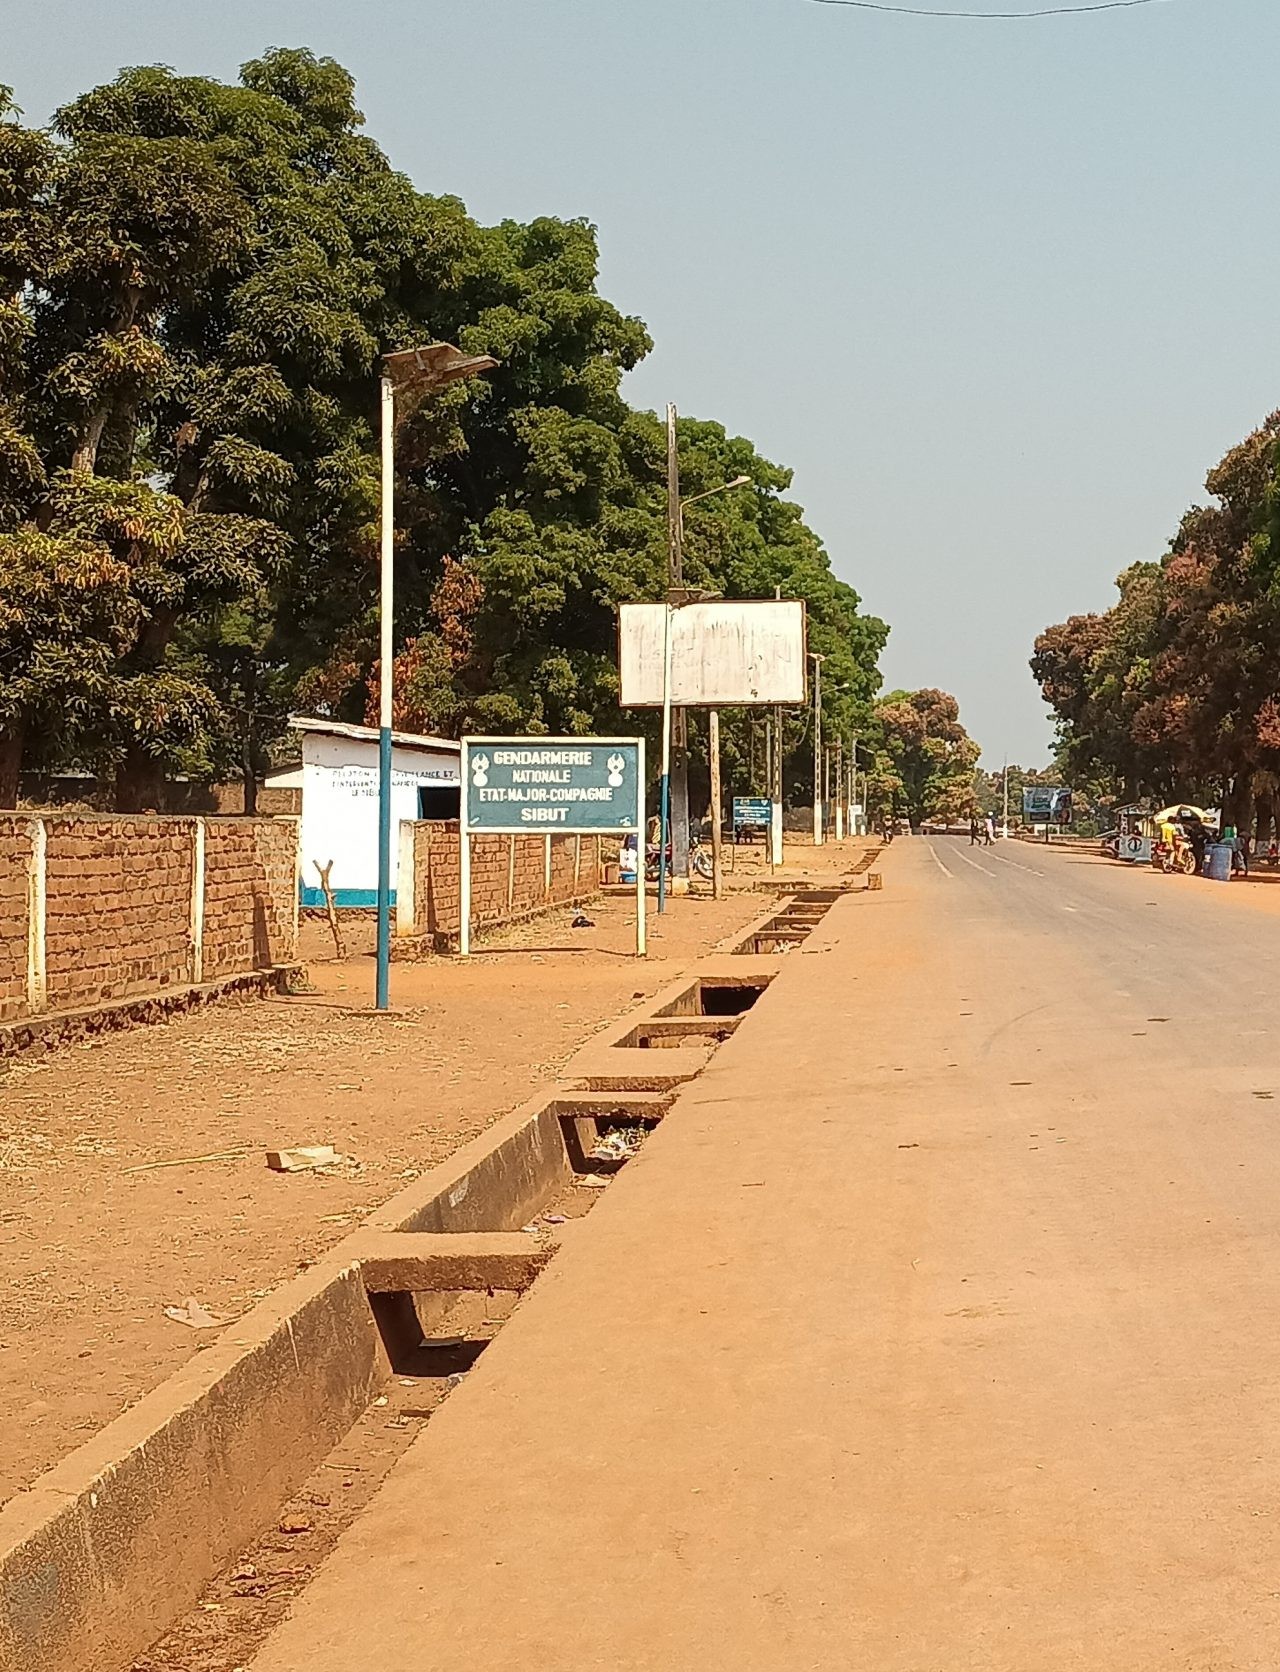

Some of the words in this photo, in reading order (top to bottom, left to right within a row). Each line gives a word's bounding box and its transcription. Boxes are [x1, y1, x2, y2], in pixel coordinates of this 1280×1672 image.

[494, 751, 592, 766] GENDARMERIE
[512, 769, 571, 784] NATIONALE
[479, 787, 612, 802] ETAT-MAJOR-COMPAGNIE
[521, 807, 569, 822] SIBUT
